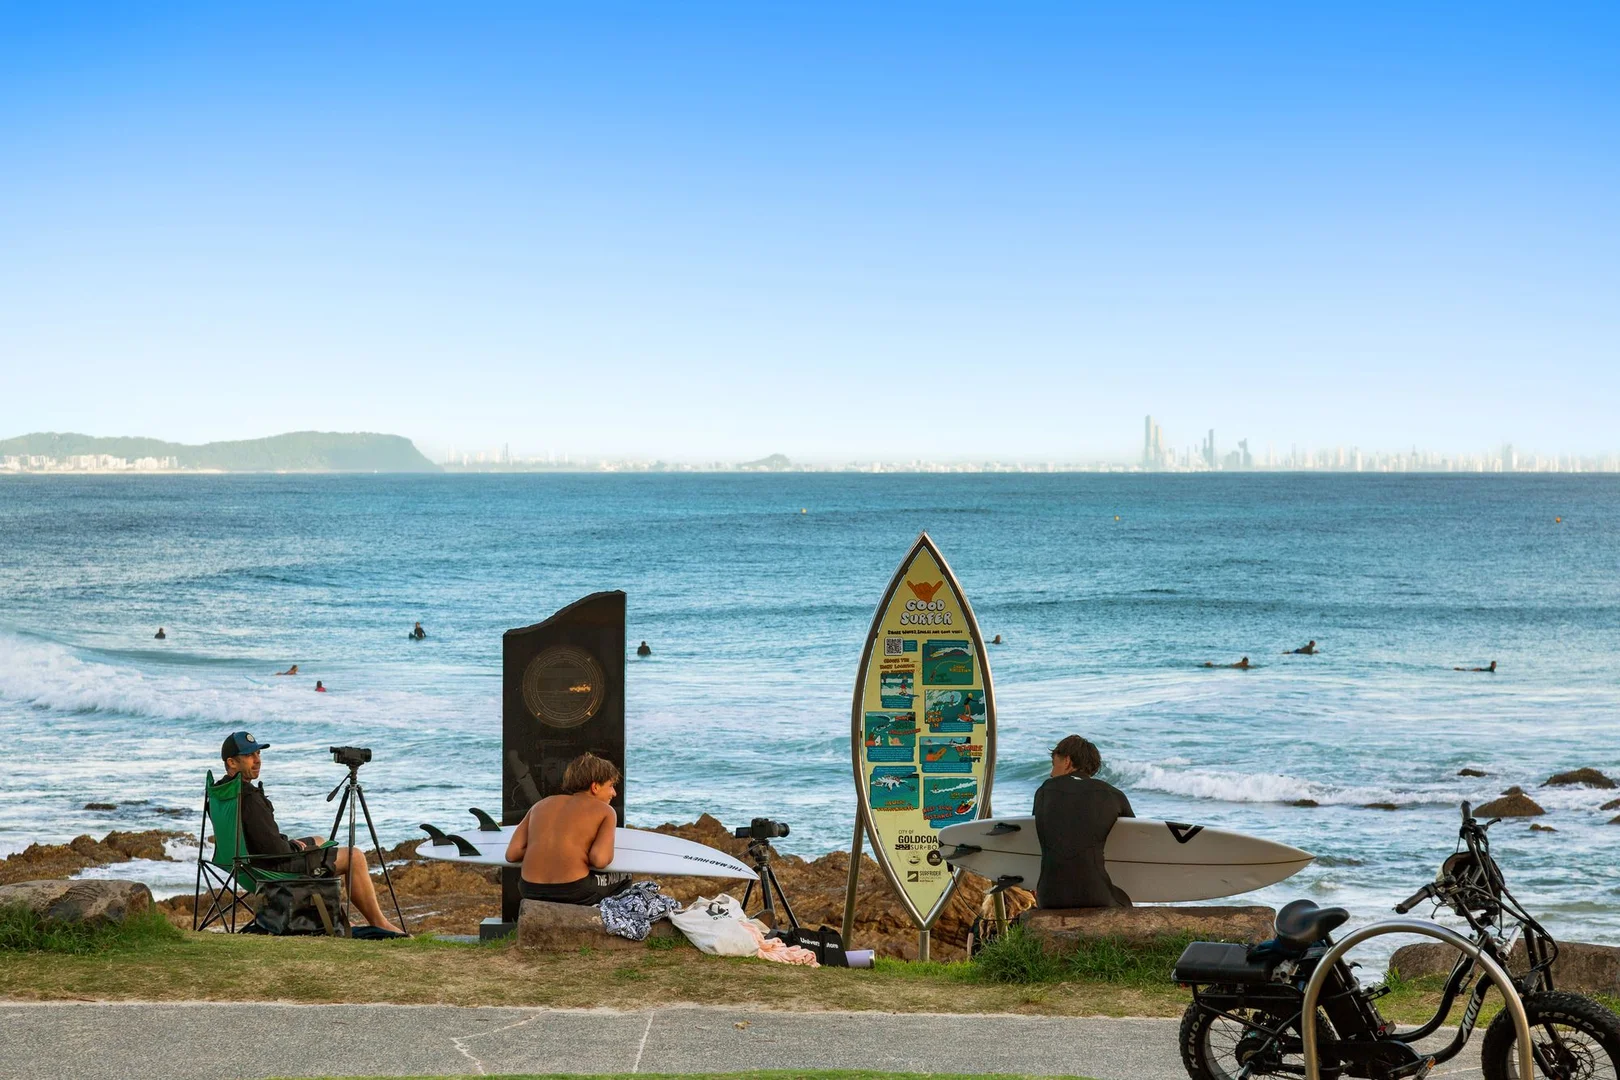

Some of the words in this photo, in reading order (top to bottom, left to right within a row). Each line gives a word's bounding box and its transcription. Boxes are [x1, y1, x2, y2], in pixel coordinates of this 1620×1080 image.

[906, 599, 945, 611] GOOD
[900, 612, 952, 625] SURFER
[898, 835, 938, 843] GOLDCOA
[683, 855, 709, 863] HUEYS
[595, 874, 607, 886] THE
[800, 937, 820, 947] Univers
[1538, 1012, 1605, 1039] KENDA
[1188, 1013, 1206, 1068] KENDA
